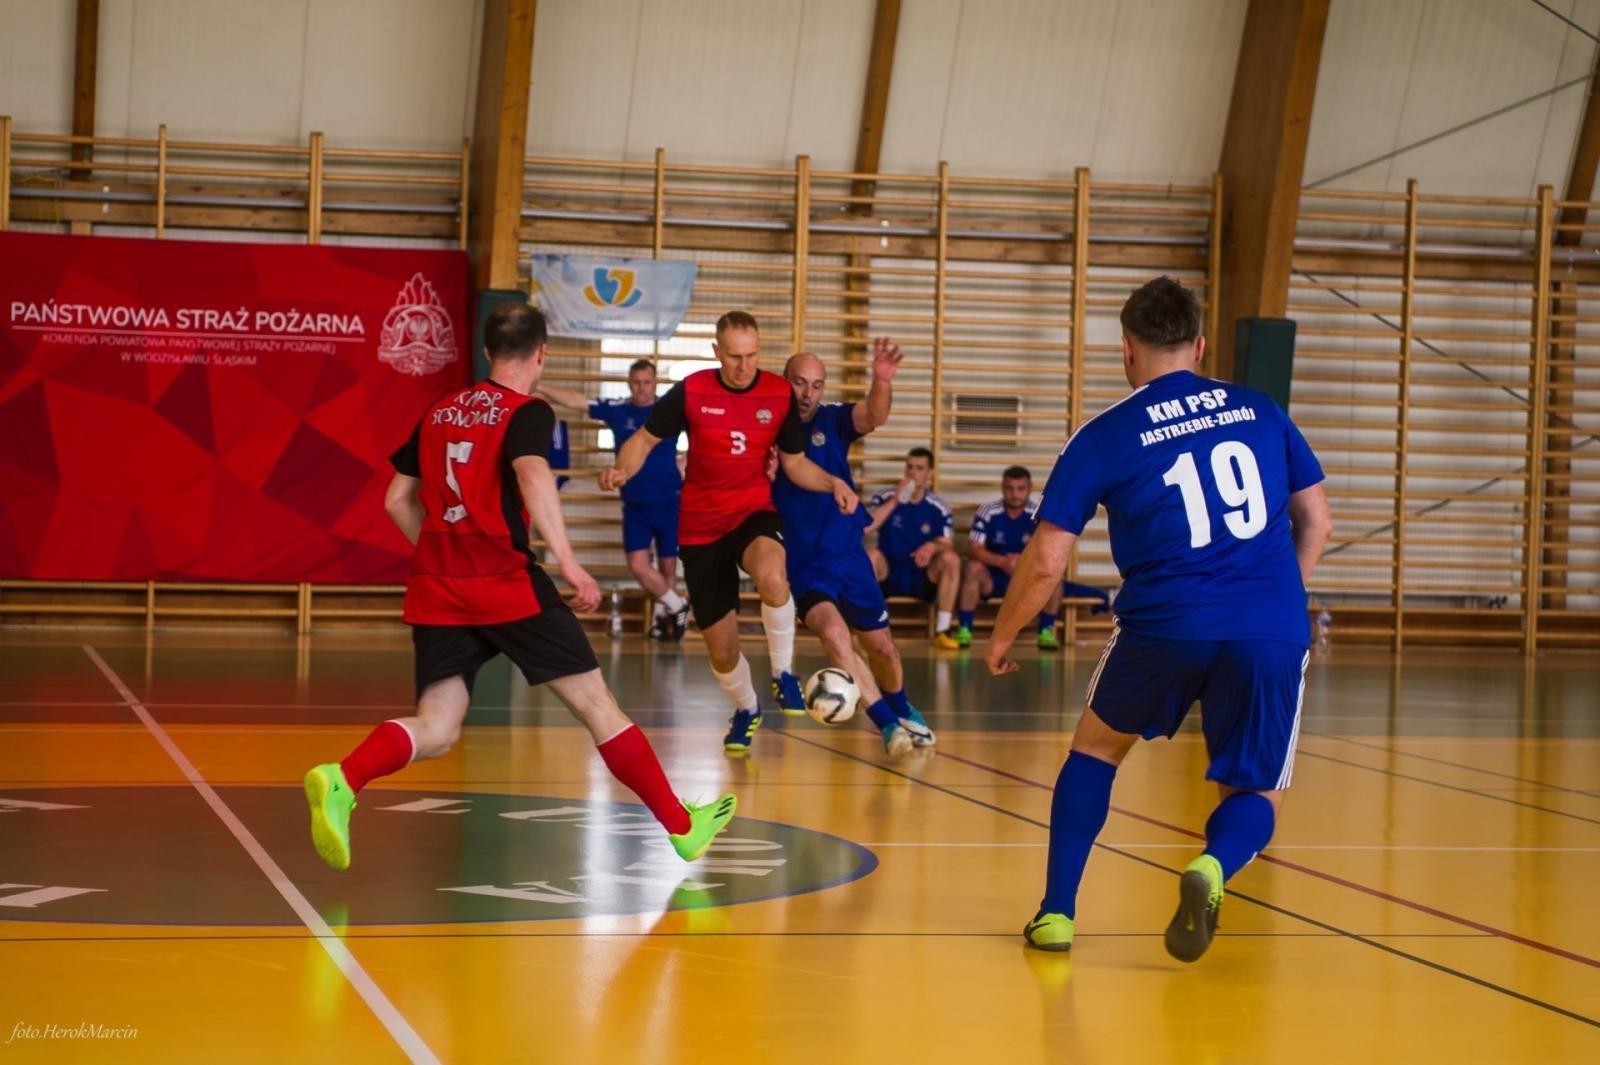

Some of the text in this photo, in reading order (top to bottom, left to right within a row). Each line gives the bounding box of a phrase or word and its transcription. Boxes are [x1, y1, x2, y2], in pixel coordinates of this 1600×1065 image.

[10, 299, 365, 334] PAŃSTWOWA STRAŻ POŻARNA
[43, 333, 98, 345] KOMENDA
[100, 335, 166, 348] POWIATOWA
[120, 352, 131, 362] W
[134, 352, 210, 366] WODZISŁAWIU
[1146, 388, 1228, 424] KM PSP
[730, 431, 747, 455] 3
[1140, 406, 1257, 447] JASTRZĘBIE-ZDRÓJ
[1162, 440, 1268, 549] 19
